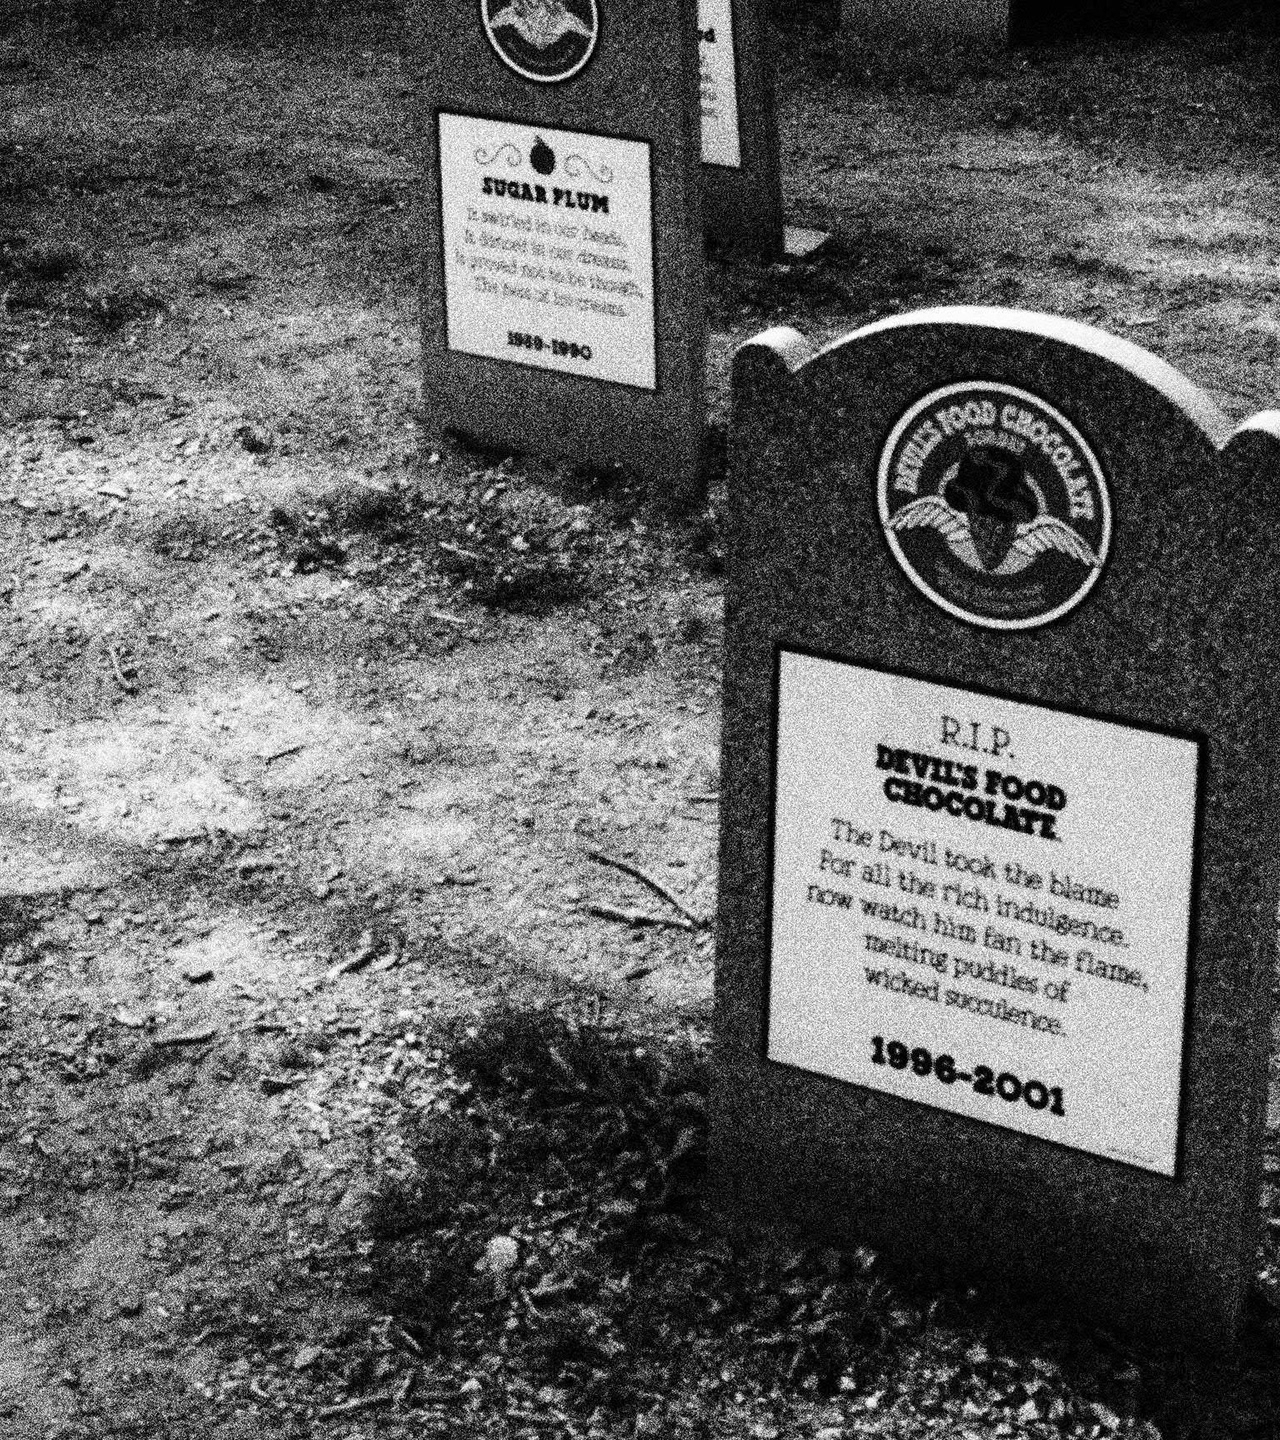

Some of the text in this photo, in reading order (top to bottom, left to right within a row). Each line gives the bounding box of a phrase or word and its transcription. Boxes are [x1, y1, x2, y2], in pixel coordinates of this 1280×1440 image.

[482, 176, 608, 213] SUGAR PLUM
[893, 419, 945, 496] DEVIL'S
[935, 399, 997, 437] FOOD
[940, 714, 1014, 759] R.I.P.
[875, 743, 1066, 811] DEVIL'S FOOD
[818, 848, 856, 877] For
[861, 863, 891, 887] all
[897, 871, 935, 898] the
[942, 883, 989, 912] rich
[831, 817, 1119, 909] The Devil took the blame
[807, 884, 1148, 992] now watch him fan the flame,
[864, 933, 1070, 1003] melting puddles of
[864, 967, 1066, 1036] wicked succulence.
[871, 1035, 1065, 1116] 1996-2001
